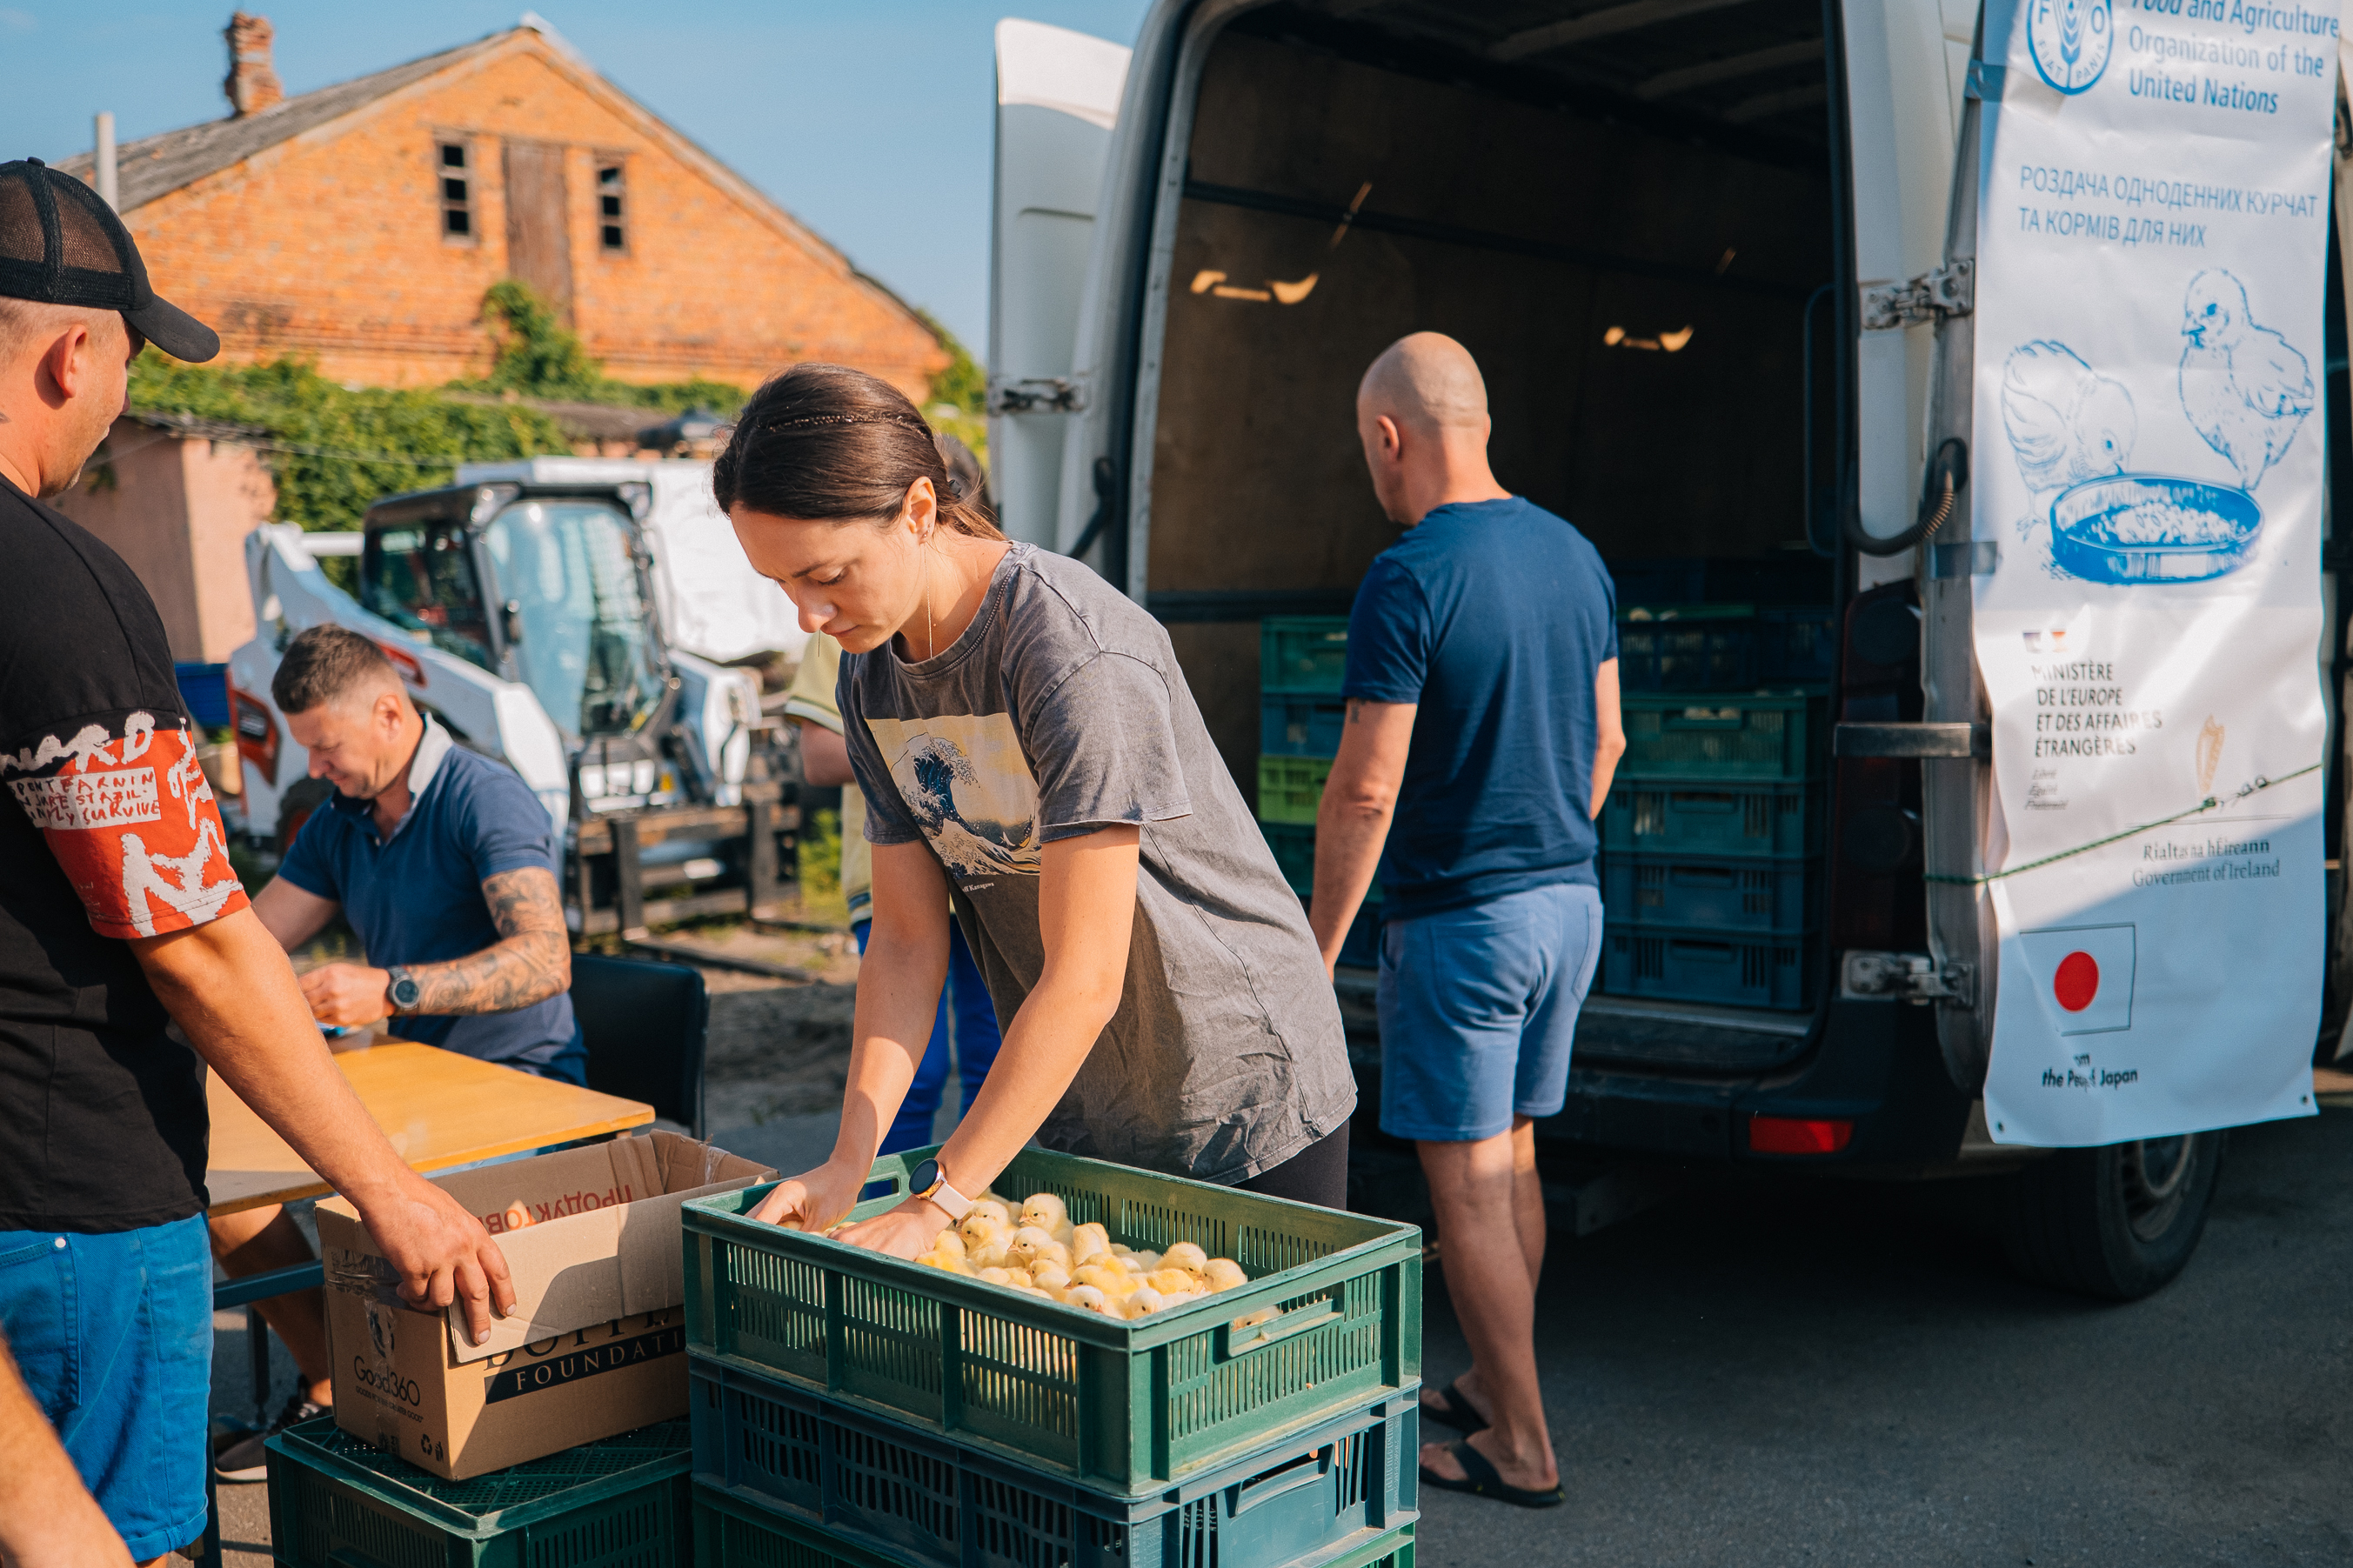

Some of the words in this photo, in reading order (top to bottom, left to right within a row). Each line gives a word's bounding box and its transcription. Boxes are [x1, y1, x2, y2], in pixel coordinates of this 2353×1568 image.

[2187, 0, 2224, 23] and
[2229, 0, 2340, 39] Agriculture
[2129, 25, 2260, 70] Organization
[2266, 43, 2288, 72] of
[2294, 47, 2324, 78] the
[2129, 68, 2197, 104] United
[2203, 78, 2279, 115] Nations
[2020, 165, 2109, 201] РОЗДАЧА
[2114, 176, 2244, 213] ОДНОДЕННИХ
[2246, 190, 2319, 217] КУРЧАТ
[2018, 206, 2041, 233] ТА
[2045, 209, 2121, 241] КОРМІВ
[2122, 217, 2165, 248] ДЛЯ
[2168, 221, 2208, 249] НИХ
[2031, 658, 2114, 681] MINISTÈRE
[2036, 688, 2056, 706] DE
[2061, 687, 2123, 706] L'EUROPE
[2036, 713, 2053, 731] ET
[2056, 712, 2082, 731] DES
[2085, 709, 2163, 731] AFFAIRES
[2035, 735, 2136, 758] ÉTRANGÈRES
[2229, 858, 2280, 881] Ireland
[2042, 1066, 2064, 1087] the
[2099, 1067, 2138, 1091] Japan
[478, 1184, 633, 1235] ПРОДУКТОВ
[353, 1355, 421, 1407] Good360
[515, 1330, 681, 1391] FOUNDATI
